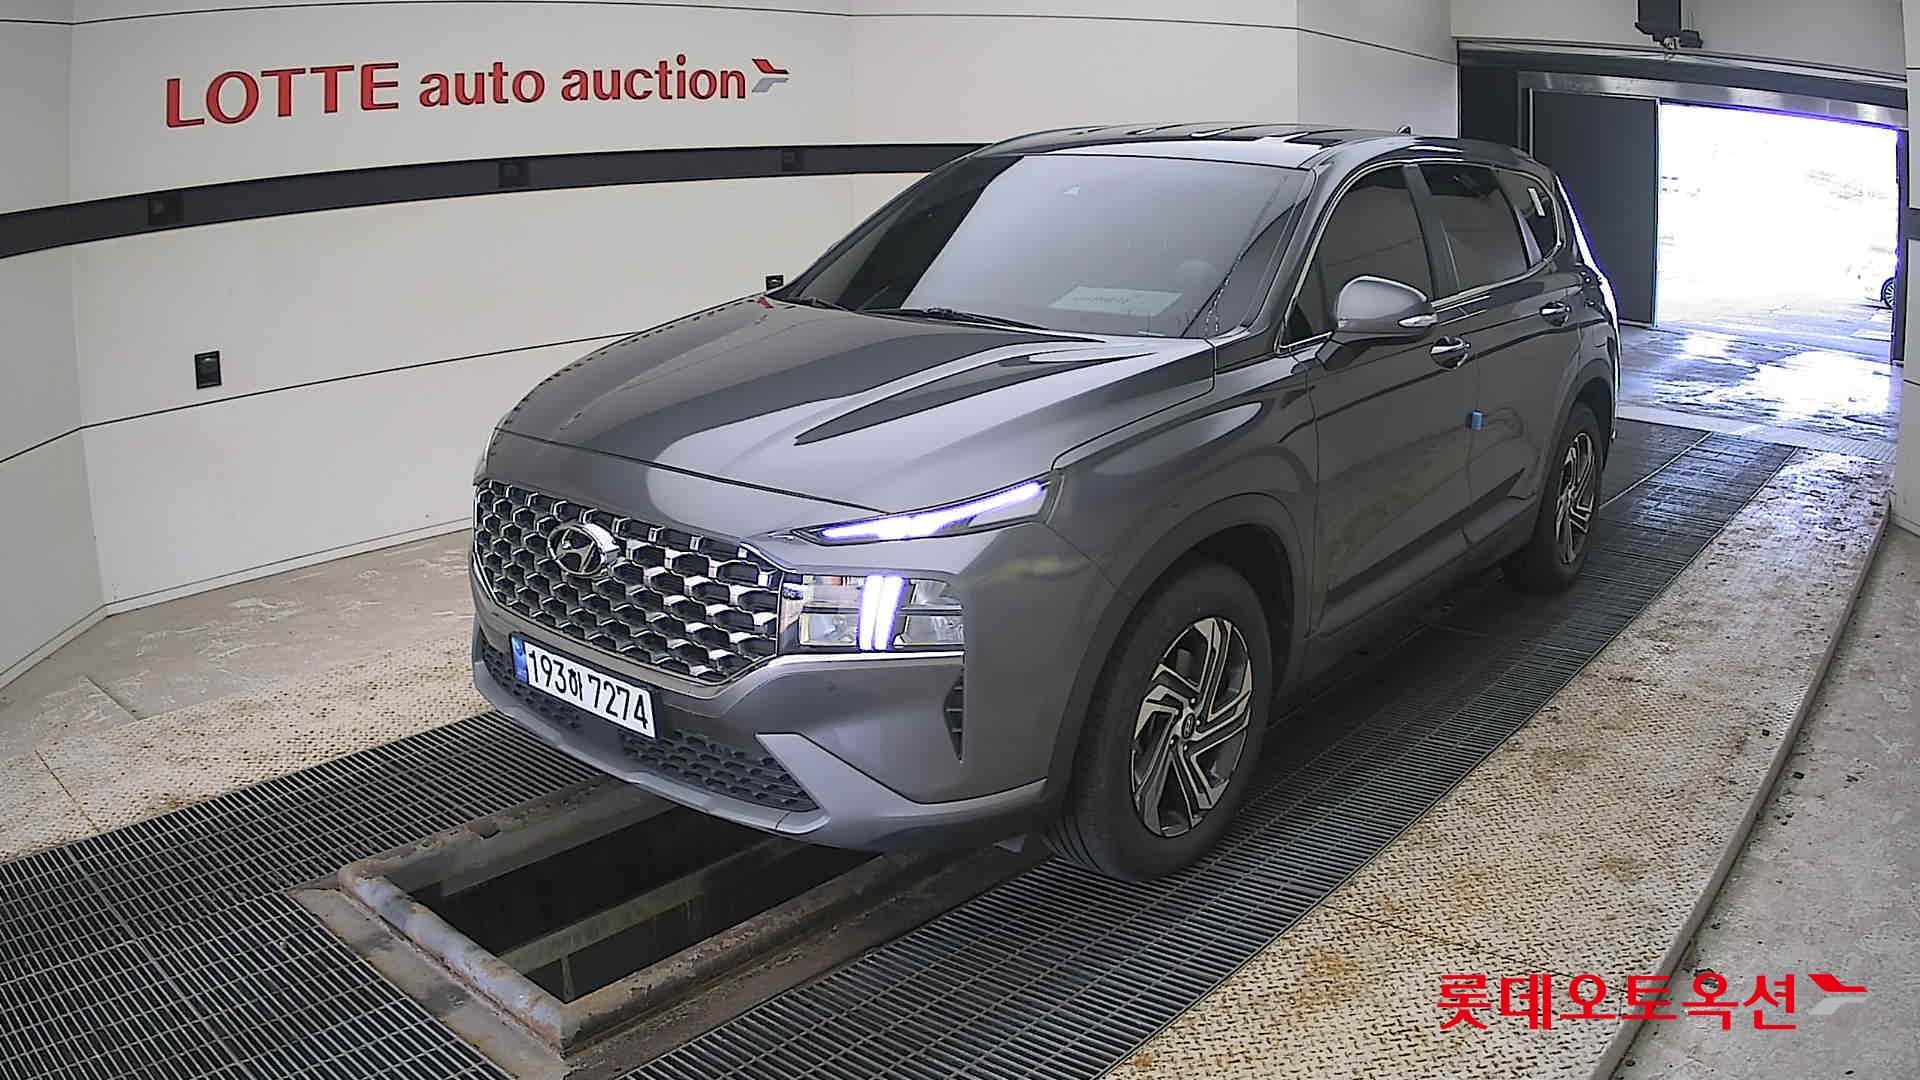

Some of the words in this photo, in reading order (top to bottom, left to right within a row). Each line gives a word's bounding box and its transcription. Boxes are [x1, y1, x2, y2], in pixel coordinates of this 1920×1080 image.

[166, 62, 400, 128] LOTTE
[419, 61, 545, 107] auto
[561, 54, 747, 102] auction
[588, 674, 648, 729] 7274
